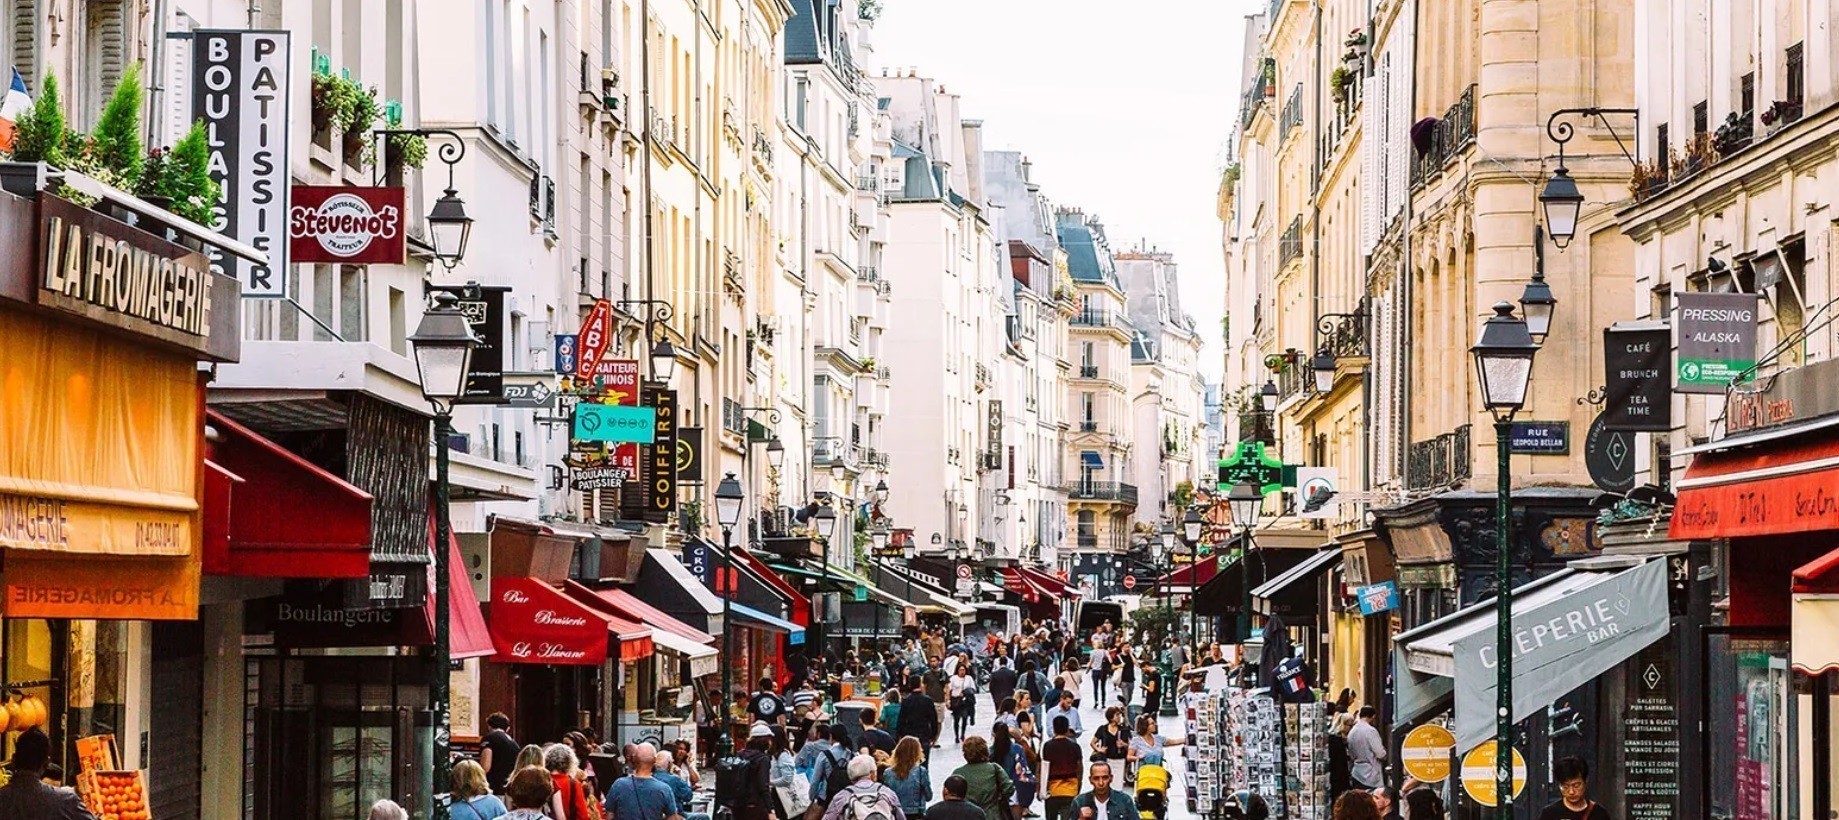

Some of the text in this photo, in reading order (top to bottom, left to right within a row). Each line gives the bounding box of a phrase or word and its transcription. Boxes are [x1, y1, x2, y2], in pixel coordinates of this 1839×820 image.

[250, 38, 278, 290] PATISSIER
[47, 216, 214, 336] LA FROMAGERIE
[1682, 309, 1752, 322] PRESSING
[581, 307, 606, 373] TABAC
[1693, 332, 1741, 342] ALASKA
[1626, 342, 1651, 353] CAFÉ
[595, 363, 637, 374] RAITEUR
[1620, 369, 1658, 379] BRUNCH
[504, 386, 528, 397] FDJ
[1630, 396, 1648, 404] TEA
[1628, 406, 1650, 415] TIME
[656, 393, 671, 509] COIFFIRST
[576, 469, 627, 480] BOULANGER
[578, 479, 622, 490] PATISSIER
[504, 591, 529, 604] Bar
[279, 603, 392, 627] Boulangerie
[535, 610, 587, 627] Brasserie
[1479, 598, 1615, 670] CÊPERIE
[1588, 622, 1620, 644] BAR
[512, 642, 586, 658] Le Havane
